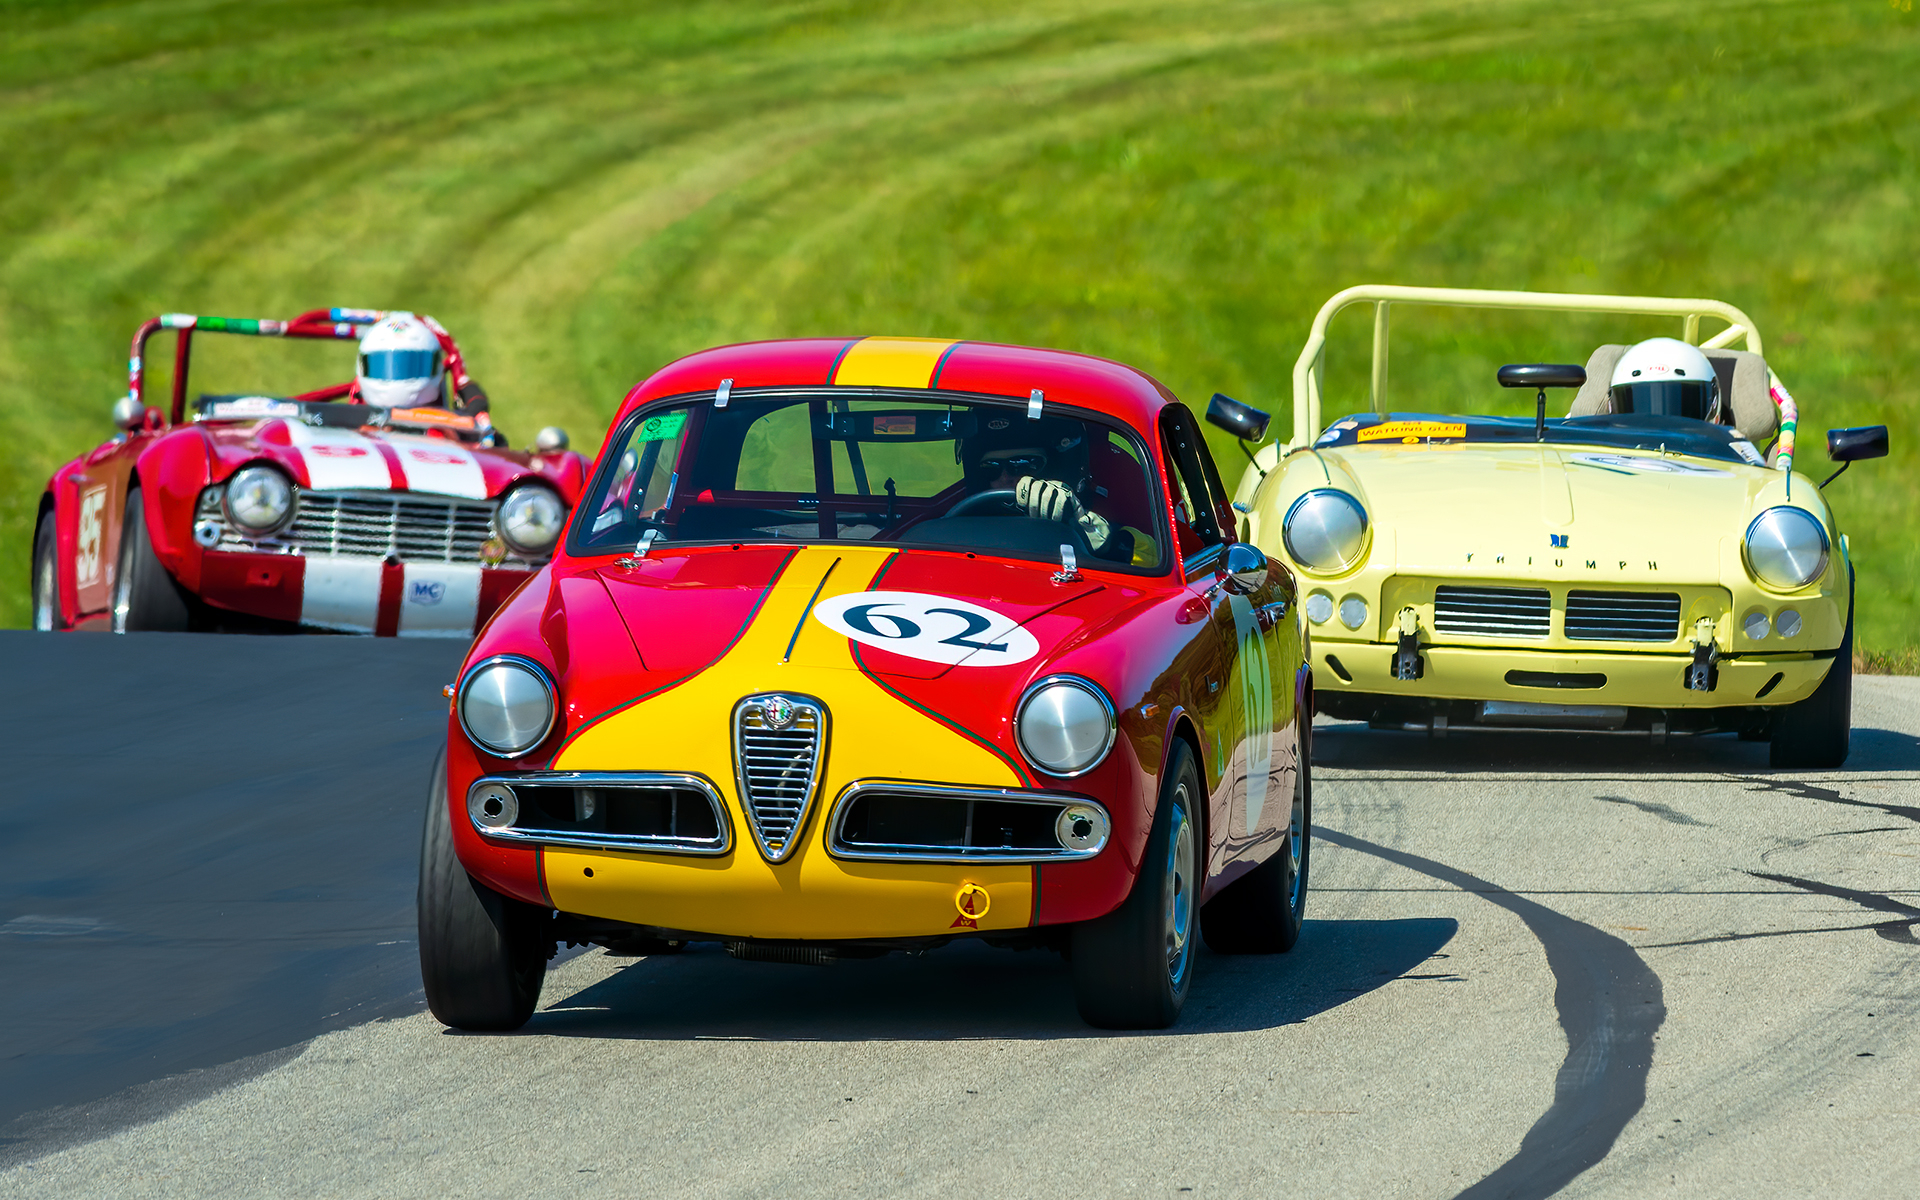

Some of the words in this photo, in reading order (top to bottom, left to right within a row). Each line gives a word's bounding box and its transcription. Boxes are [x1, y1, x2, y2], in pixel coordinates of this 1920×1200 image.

[1466, 552, 1658, 571] TRIUMPH
[842, 603, 1009, 652] 62
[1244, 626, 1270, 769] 62
